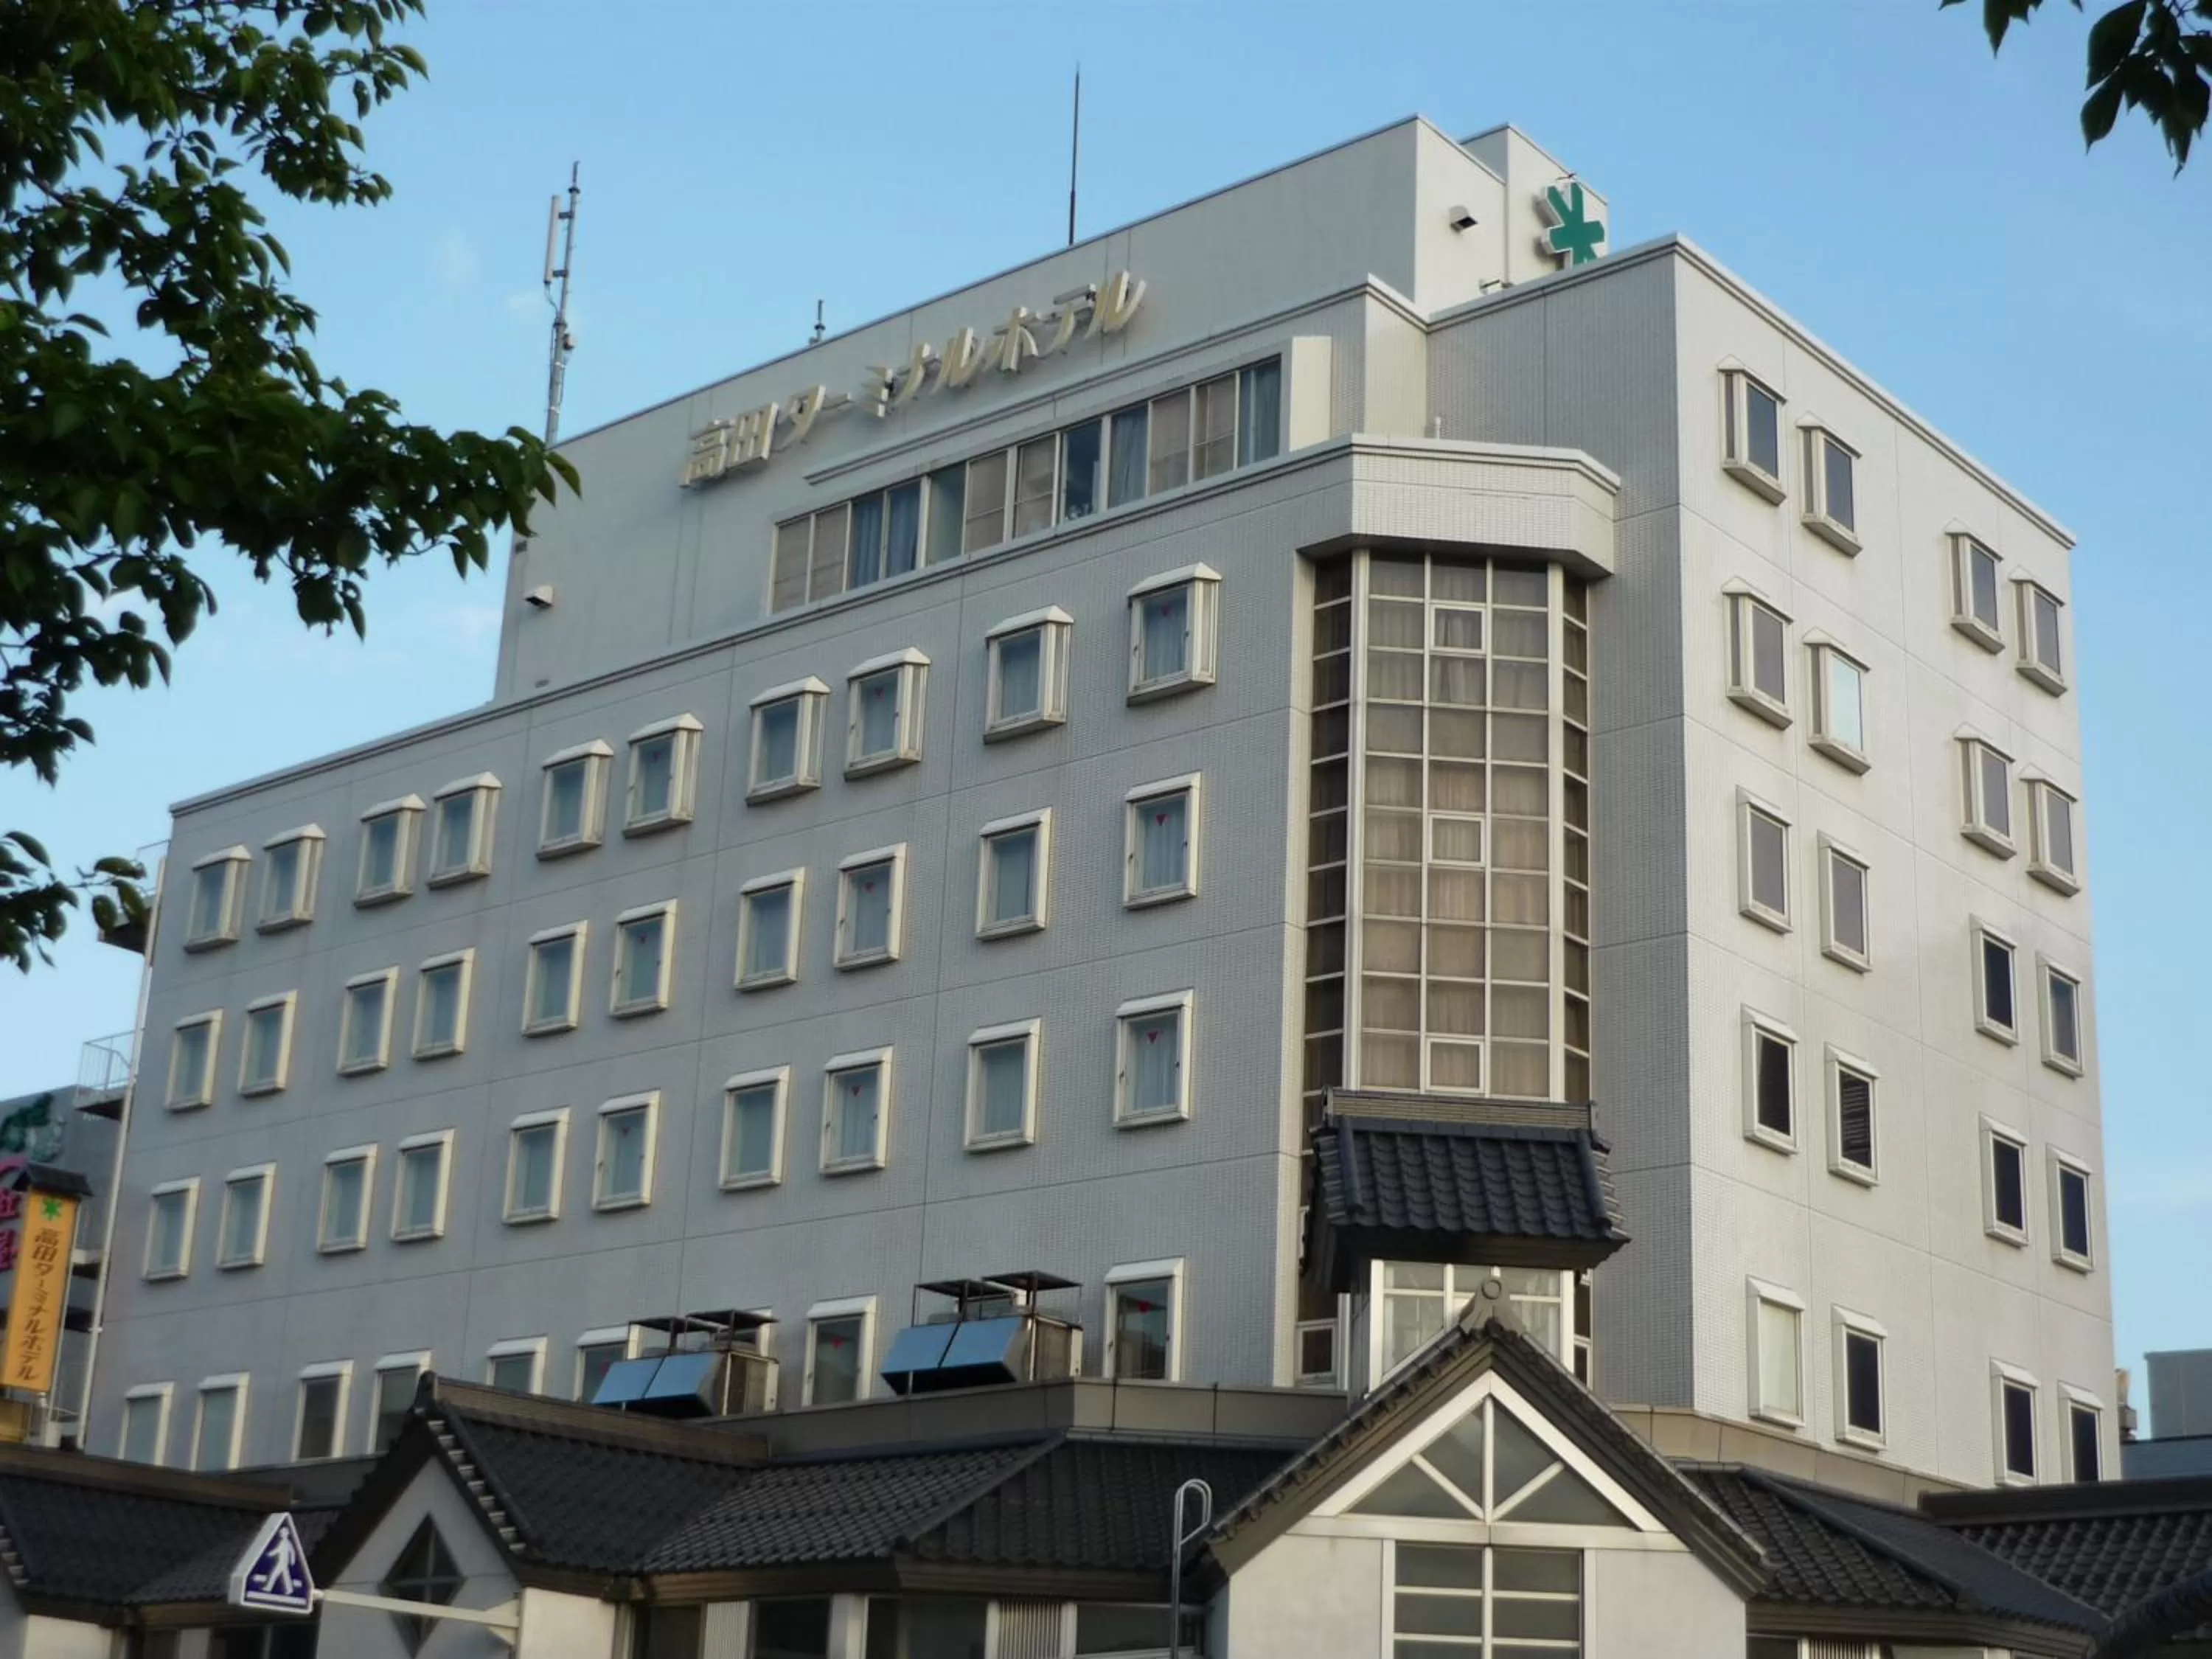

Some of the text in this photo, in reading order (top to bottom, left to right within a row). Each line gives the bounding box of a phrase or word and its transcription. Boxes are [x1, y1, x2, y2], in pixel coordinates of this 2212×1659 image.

[17, 1228, 62, 1381] 高田ターミナルホテル
